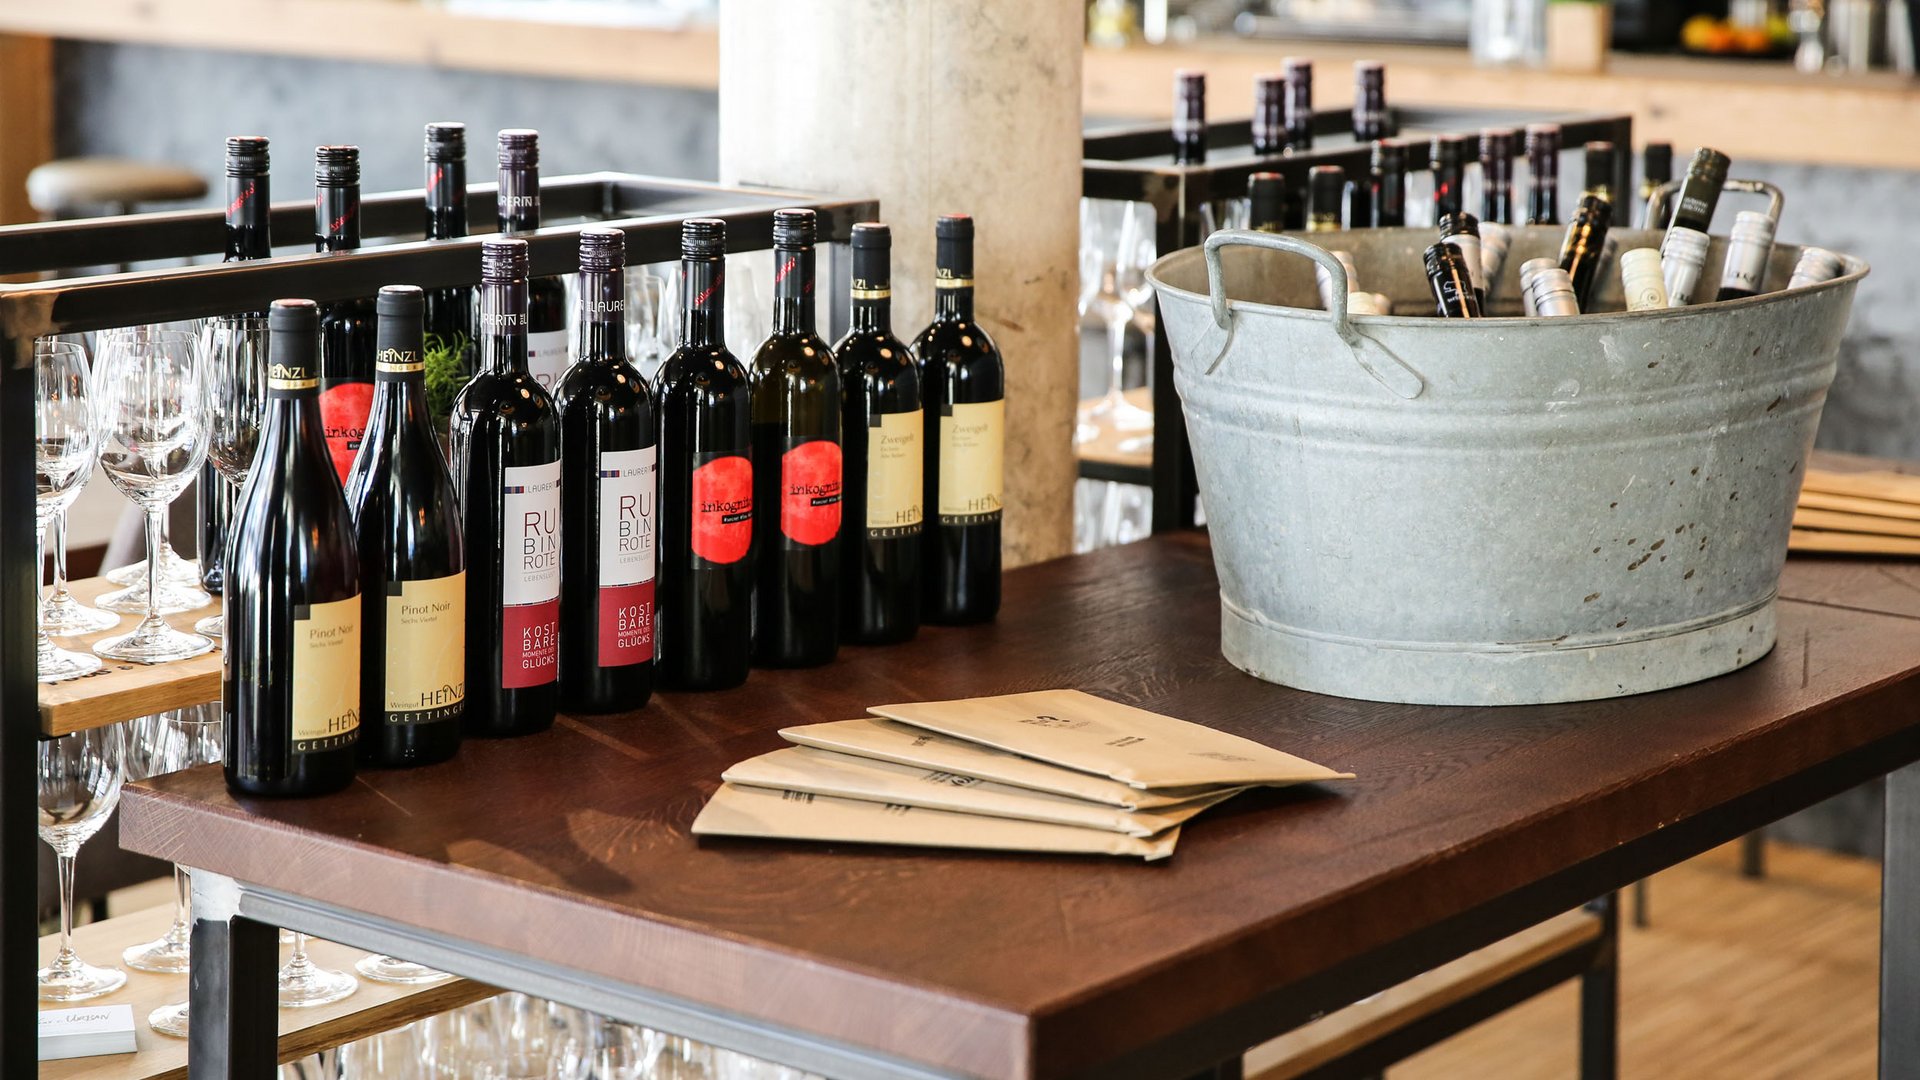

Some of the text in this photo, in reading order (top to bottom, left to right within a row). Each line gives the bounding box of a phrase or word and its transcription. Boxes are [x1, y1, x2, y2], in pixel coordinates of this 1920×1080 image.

[620, 492, 651, 520] RU
[524, 508, 556, 537] RU
[620, 517, 651, 537] BIN
[524, 533, 556, 555] BIN
[619, 533, 651, 552] ROTE
[523, 551, 556, 570] ROTE
[401, 601, 451, 616] Pinot Noir
[618, 602, 650, 619] KOST
[523, 622, 555, 639] KOST
[618, 614, 650, 631] BARE
[310, 627, 336, 640] Pinot
[523, 633, 555, 651] BARE
[618, 634, 650, 648] GLÜCKS
[522, 649, 547, 658] MOMENTE
[522, 654, 555, 669] GLÜCKS
